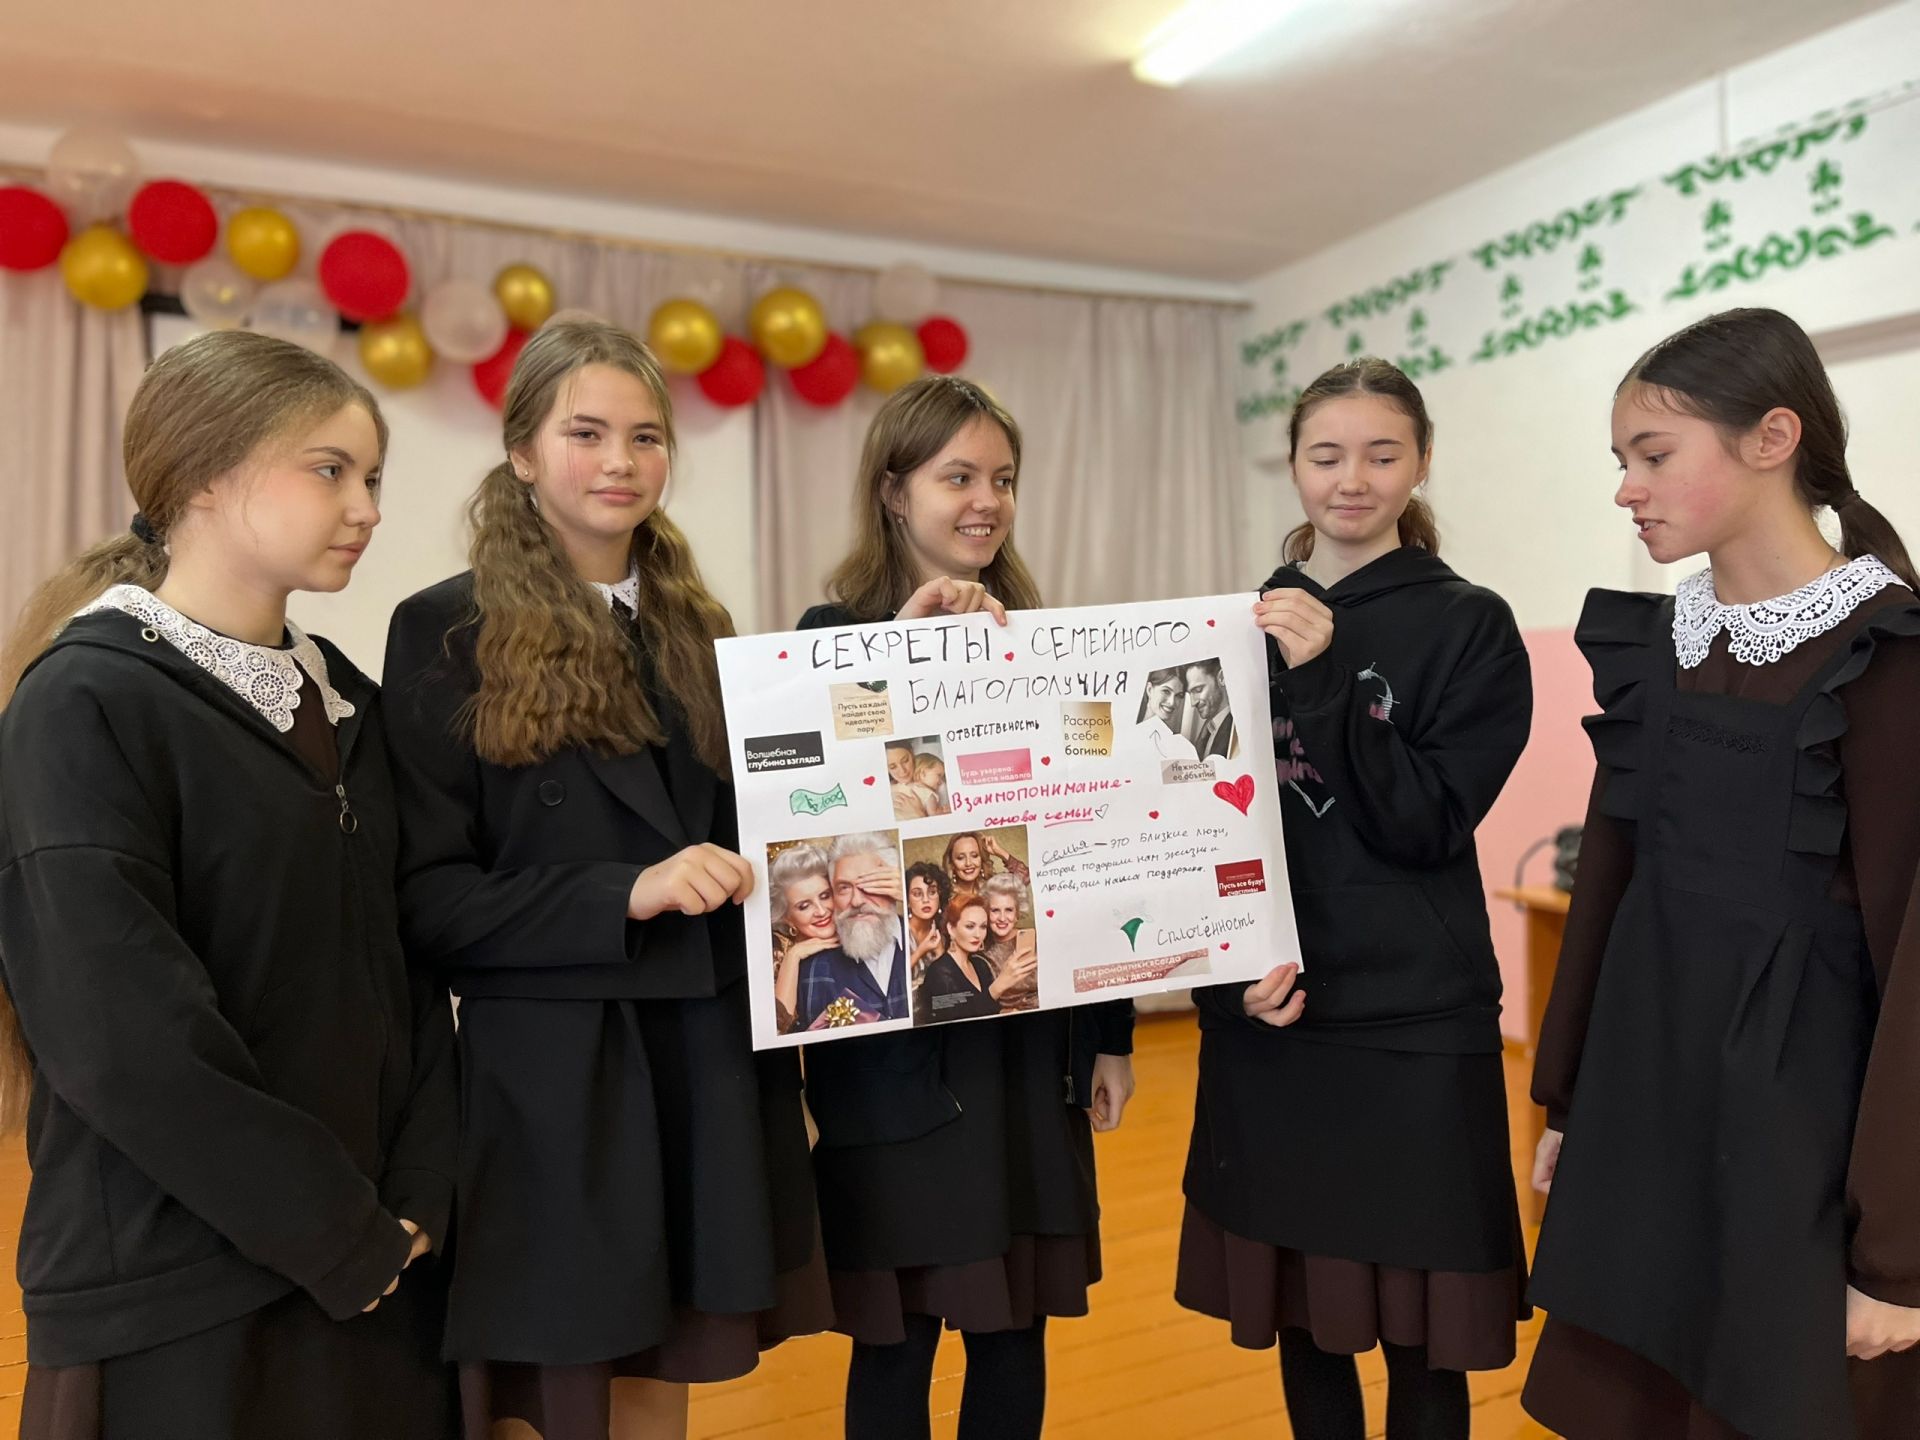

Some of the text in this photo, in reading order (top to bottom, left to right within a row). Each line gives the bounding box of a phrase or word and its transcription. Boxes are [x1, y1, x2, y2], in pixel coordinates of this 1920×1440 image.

[812, 620, 1190, 669] СЕКРЕТЫ СЕМЕЙНОГО
[909, 671, 1128, 714] БЛАГОПОЛУЧИЯ
[838, 700, 887, 711] Пусть каждый
[845, 717, 885, 726] идеальную
[1064, 714, 1111, 728] Раскрой
[1072, 731, 1100, 741] себе
[746, 748, 797, 760] Волшебная
[1065, 745, 1108, 756] богиню
[748, 755, 821, 770] глубина взгляда
[1171, 762, 1210, 771] Нежность
[1000, 772, 1031, 780] надолго
[984, 807, 1093, 827] основа семьи
[1042, 840, 1090, 866] Семья
[1137, 854, 1159, 863] нам
[1219, 883, 1236, 891] Пусть
[1247, 878, 1264, 887] будут
[1157, 912, 1255, 946] Сплочённость
[1077, 956, 1182, 980] Для романтики всегда
[1097, 975, 1129, 987] нужны
